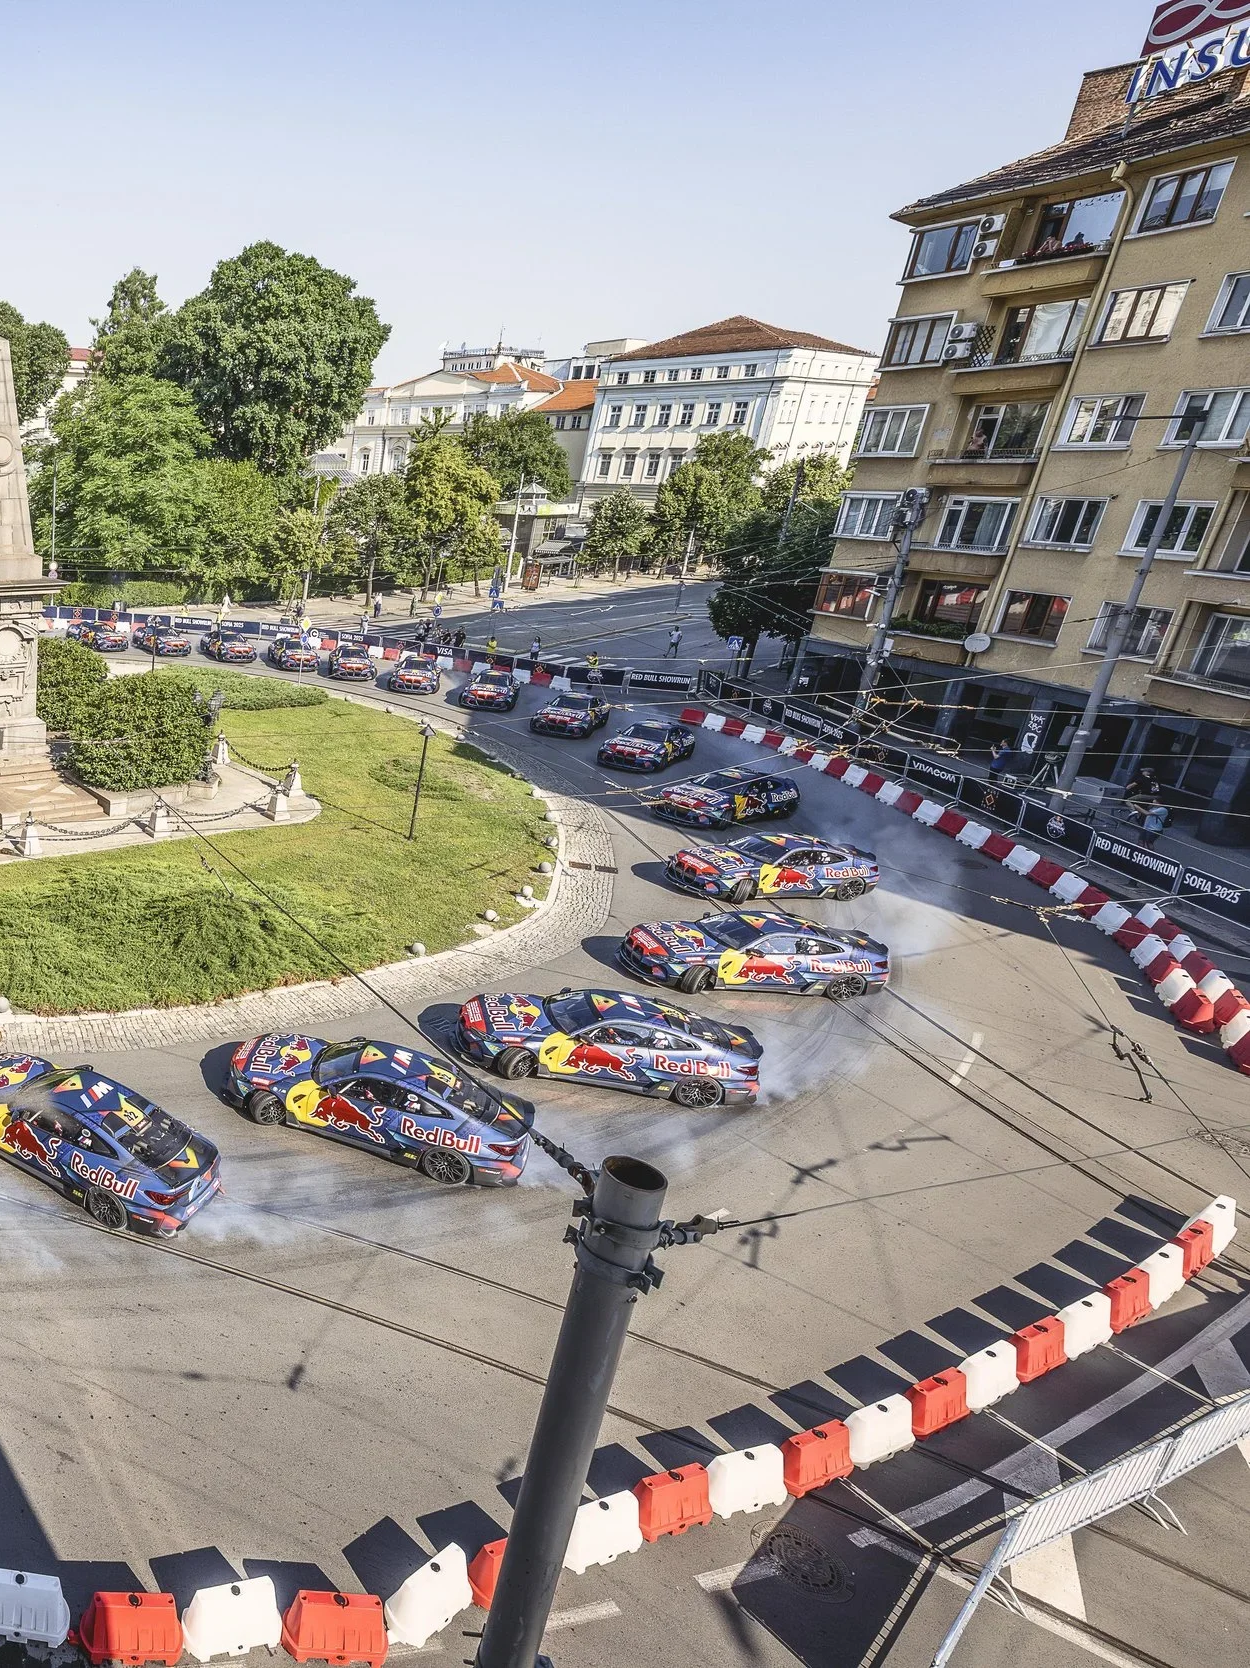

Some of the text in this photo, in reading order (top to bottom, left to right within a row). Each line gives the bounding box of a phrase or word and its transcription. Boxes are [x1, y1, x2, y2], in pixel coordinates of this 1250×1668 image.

[436, 646, 453, 656] VISA
[631, 673, 691, 685] RED BULL SHOWRUN
[912, 760, 957, 784] VIVACOM
[1095, 836, 1178, 878] RED BULL SHOWRUN
[824, 865, 870, 879] Red Bull
[1183, 873, 1241, 904] SOFIA 2025
[810, 957, 872, 974] Red Bull
[653, 1054, 732, 1079] Red Bull
[401, 1116, 481, 1155] Red Bull
[70, 1150, 141, 1200] Red Bull
